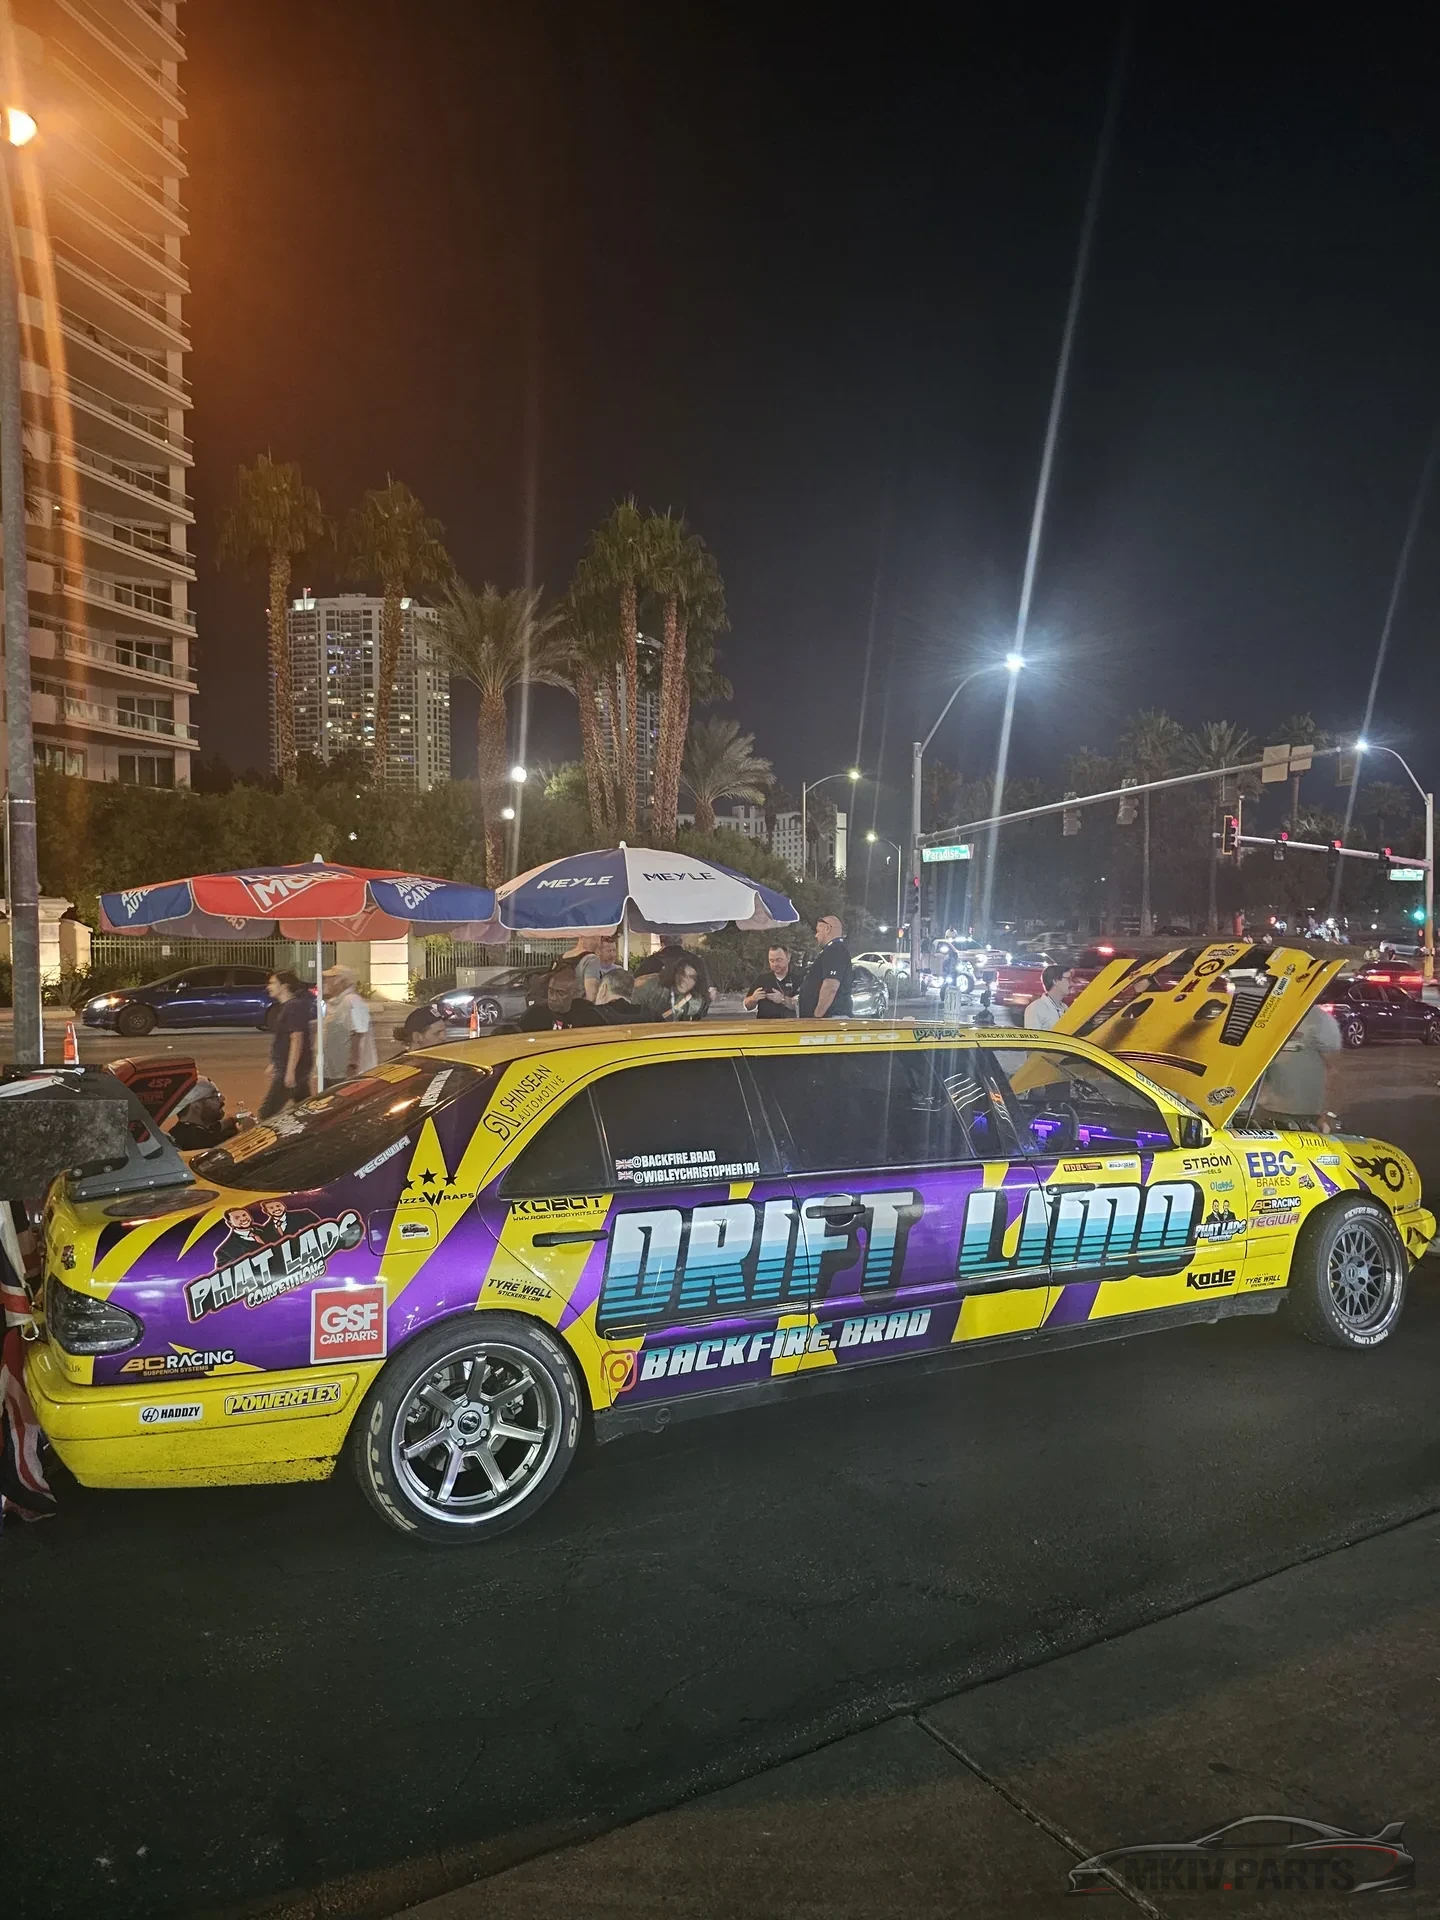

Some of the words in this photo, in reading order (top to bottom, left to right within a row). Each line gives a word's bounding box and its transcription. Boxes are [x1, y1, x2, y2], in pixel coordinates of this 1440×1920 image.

[926, 849, 960, 860] Paradise
[537, 875, 614, 889] MEYLE
[642, 871, 717, 882] MEYLE
[799, 1032, 900, 1045] NITTO
[499, 1064, 553, 1113] SHINSEAN
[517, 1075, 566, 1122] AUTOMOTIVE
[353, 1135, 411, 1180] TEGIWA
[631, 1150, 716, 1169] @BACKFIRE.BRAD
[1183, 1153, 1232, 1170] STRÖM
[1245, 1150, 1297, 1178] EBC
[1256, 1176, 1291, 1187] BRAKES
[510, 1195, 604, 1214] ROBOT
[1271, 1197, 1300, 1208] RACING
[513, 1209, 608, 1222] WWW.ROBOTBODYKITS.COM
[1250, 1213, 1300, 1228] TEGIWA
[1194, 1221, 1221, 1239] PHAT
[1221, 1219, 1247, 1236] LADS
[599, 1191, 914, 1321] DRIFT
[958, 1182, 1196, 1278] LIMO
[189, 1248, 274, 1318] PHAT
[281, 1212, 362, 1274] LADS
[247, 1259, 327, 1308] COMPETITIONS
[487, 1278, 519, 1293] TYRE
[521, 1283, 552, 1299] WALL
[1186, 1268, 1236, 1290] kode
[1245, 1277, 1262, 1285] TYRE
[497, 1289, 541, 1303] STICKERS.COM
[320, 1302, 379, 1334] GSF
[320, 1332, 344, 1345] CAR
[345, 1330, 379, 1342] PARTS
[640, 1308, 932, 1382] BACKFIRE.BRAD
[120, 1356, 166, 1372] BC
[166, 1350, 234, 1369] RACING
[180, 1365, 209, 1374] SYSTEMS
[226, 1383, 340, 1415] POWERFLEX
[160, 1405, 201, 1419] HADDZY
